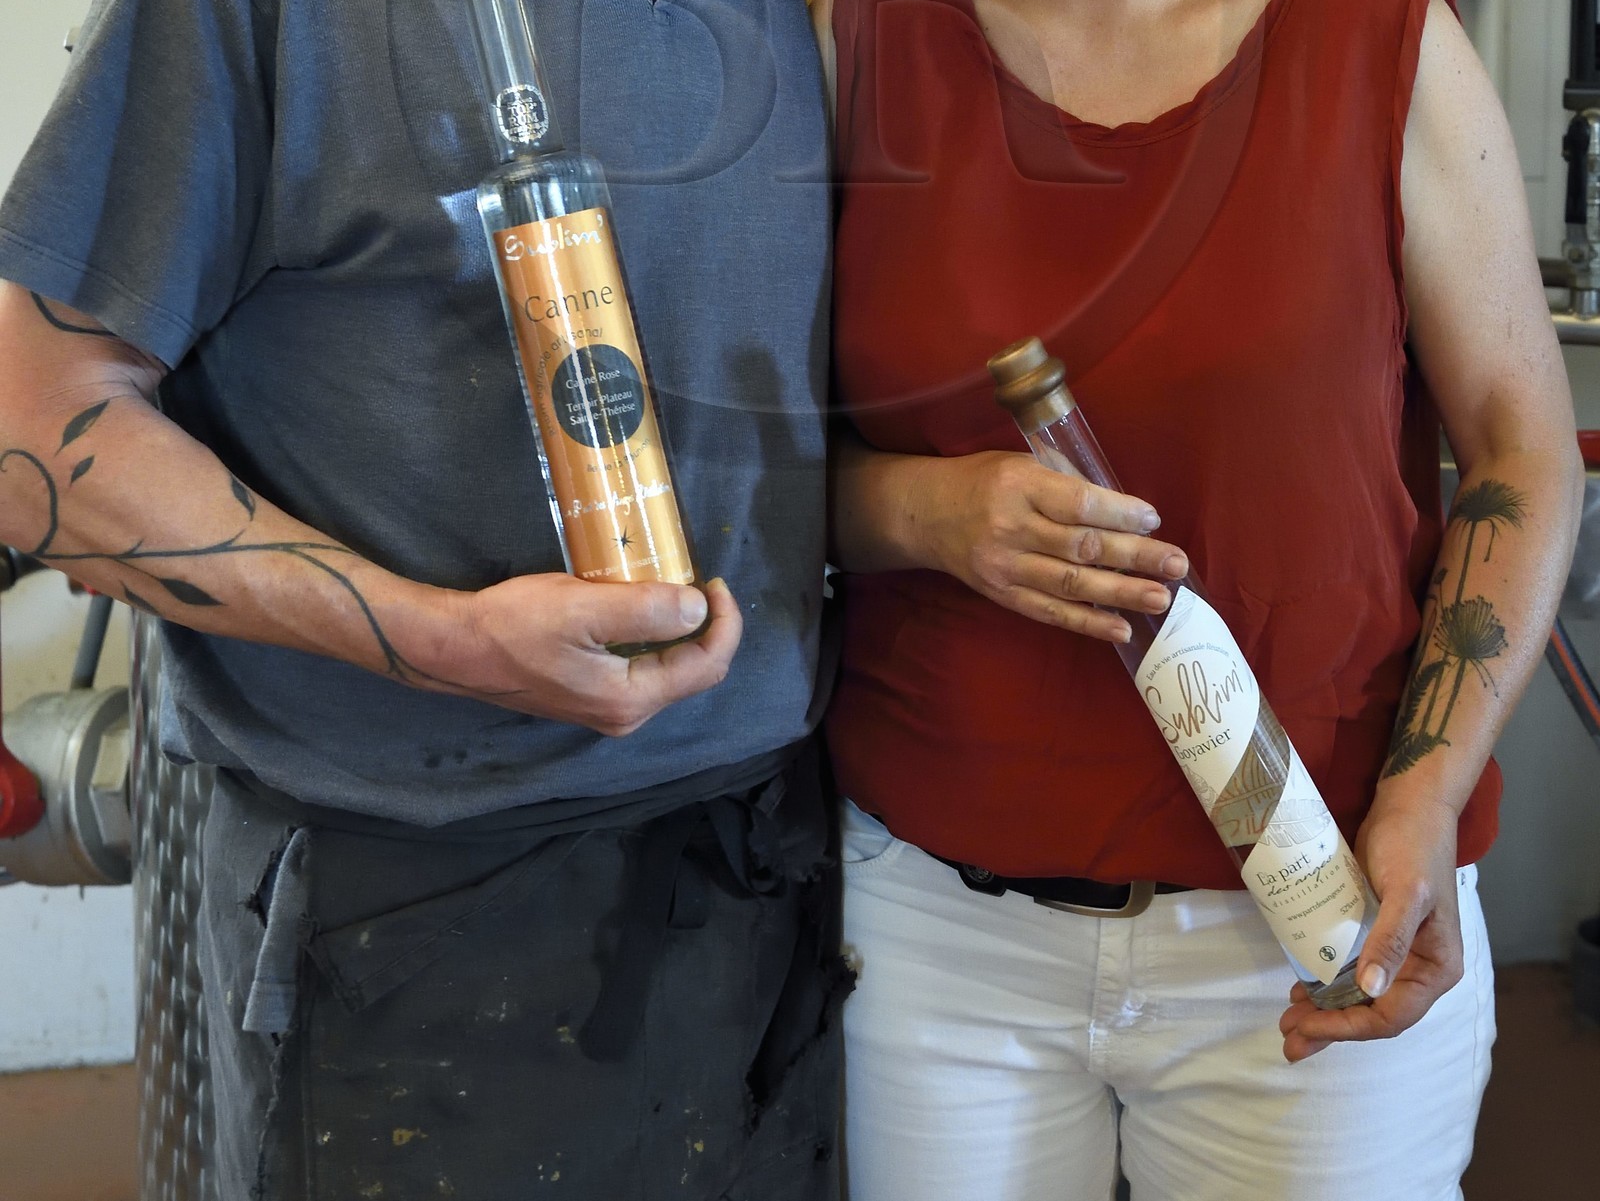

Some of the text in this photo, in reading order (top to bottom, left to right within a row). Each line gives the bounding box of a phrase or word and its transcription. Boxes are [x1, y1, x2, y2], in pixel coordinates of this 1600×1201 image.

[524, 284, 614, 323] Canne
[551, 327, 603, 351] artsanal
[565, 369, 621, 389] Cane Rose
[569, 402, 636, 426] Saine-Thérèse
[600, 390, 633, 405] Plateau
[1145, 670, 1157, 681] Eau
[1161, 655, 1171, 666] vie
[1171, 642, 1206, 660] artisanale
[1174, 727, 1232, 762] Goyavier
[1256, 851, 1312, 887] La part
[1272, 864, 1341, 909] distillation
